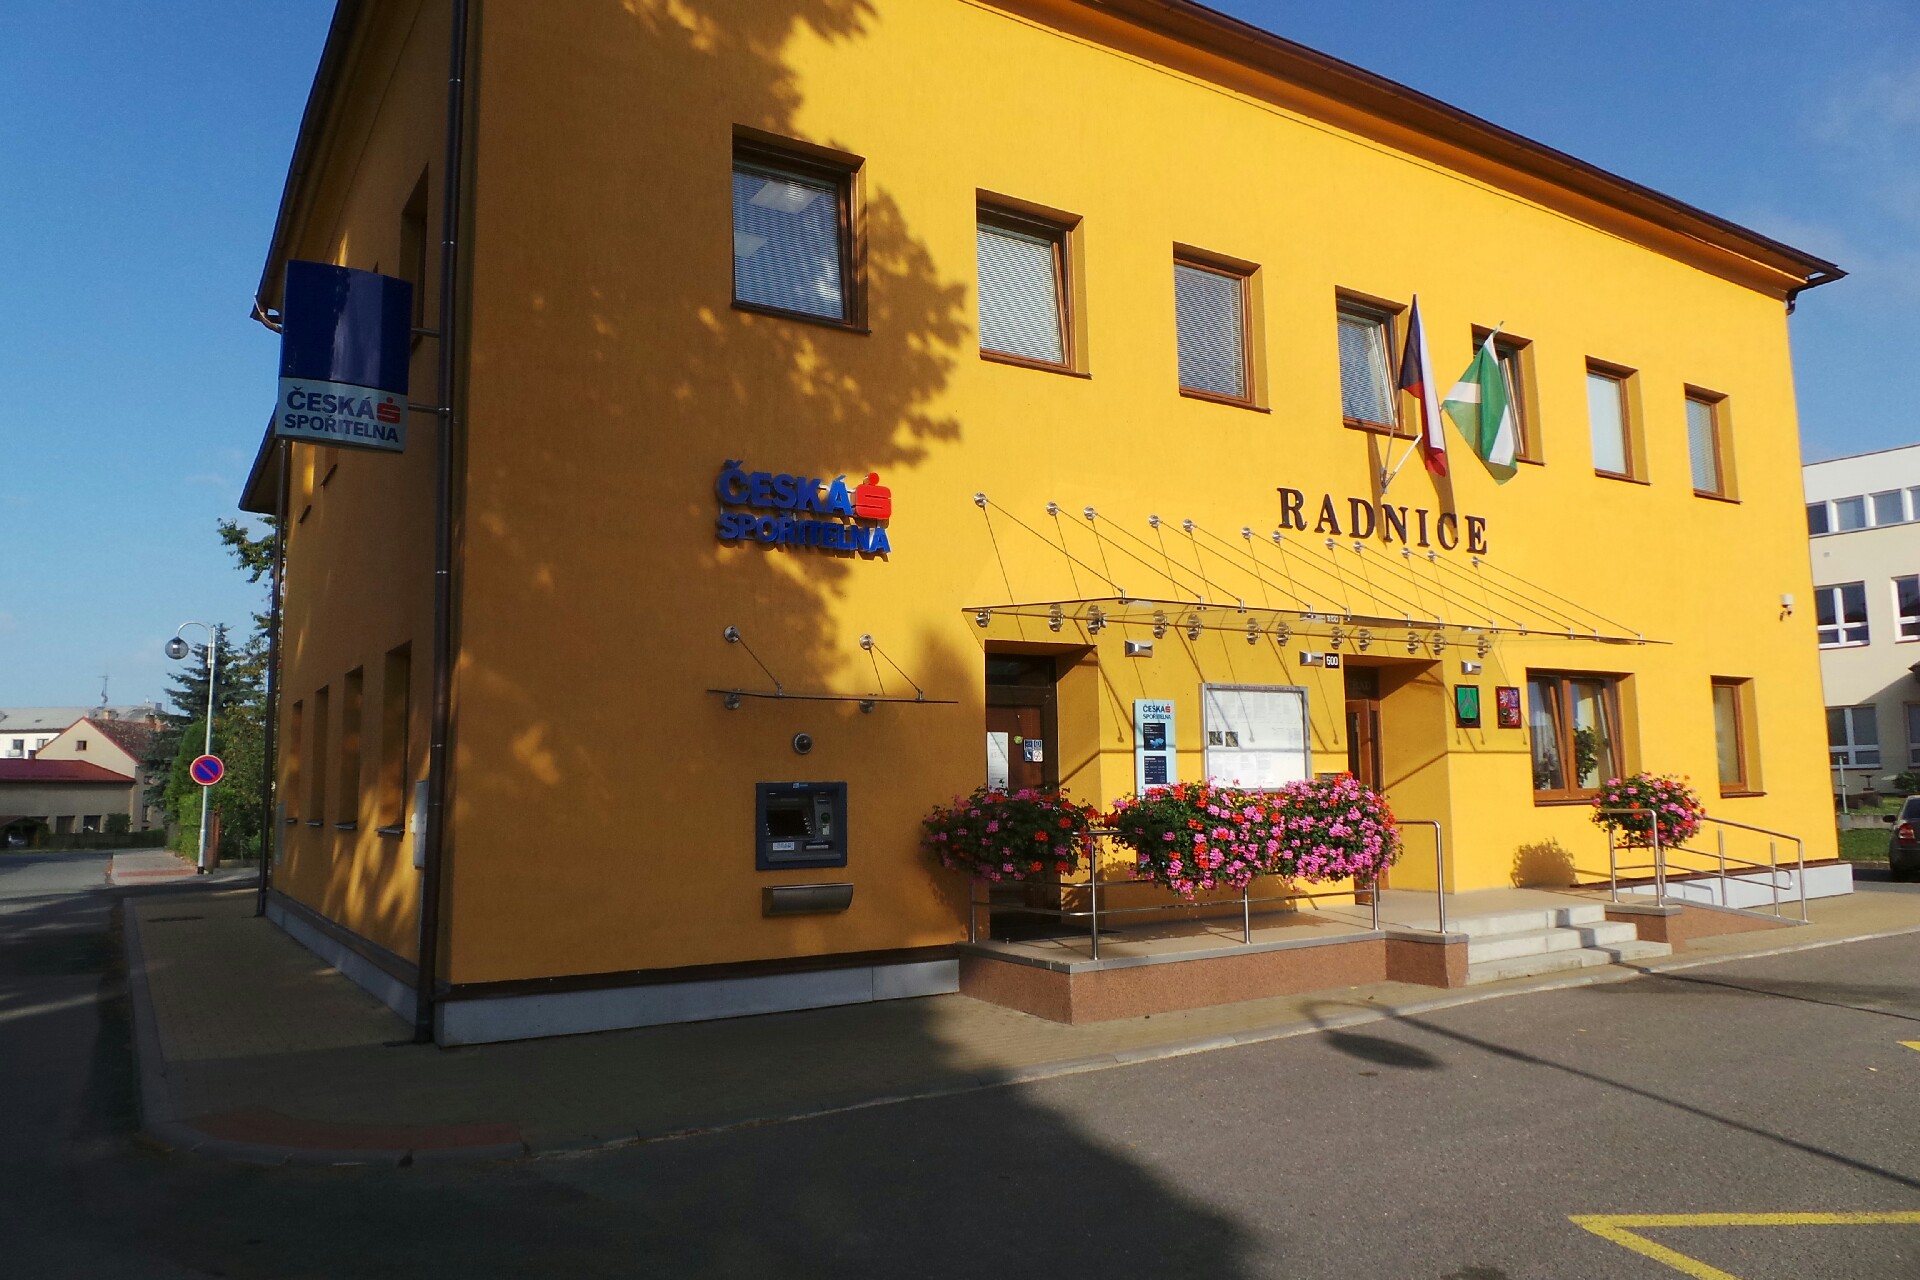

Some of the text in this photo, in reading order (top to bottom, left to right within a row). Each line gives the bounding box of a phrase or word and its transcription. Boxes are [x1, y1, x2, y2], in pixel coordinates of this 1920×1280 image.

[286, 385, 375, 420] ČESKÁ
[284, 413, 399, 443] SPOŘITELNA
[717, 459, 854, 516] ČESKÁ
[717, 511, 892, 553] SPOŘITELNA
[1276, 487, 1488, 555] RADNICE
[1326, 656, 1338, 666] 500
[1142, 704, 1165, 713] ČESKÁ
